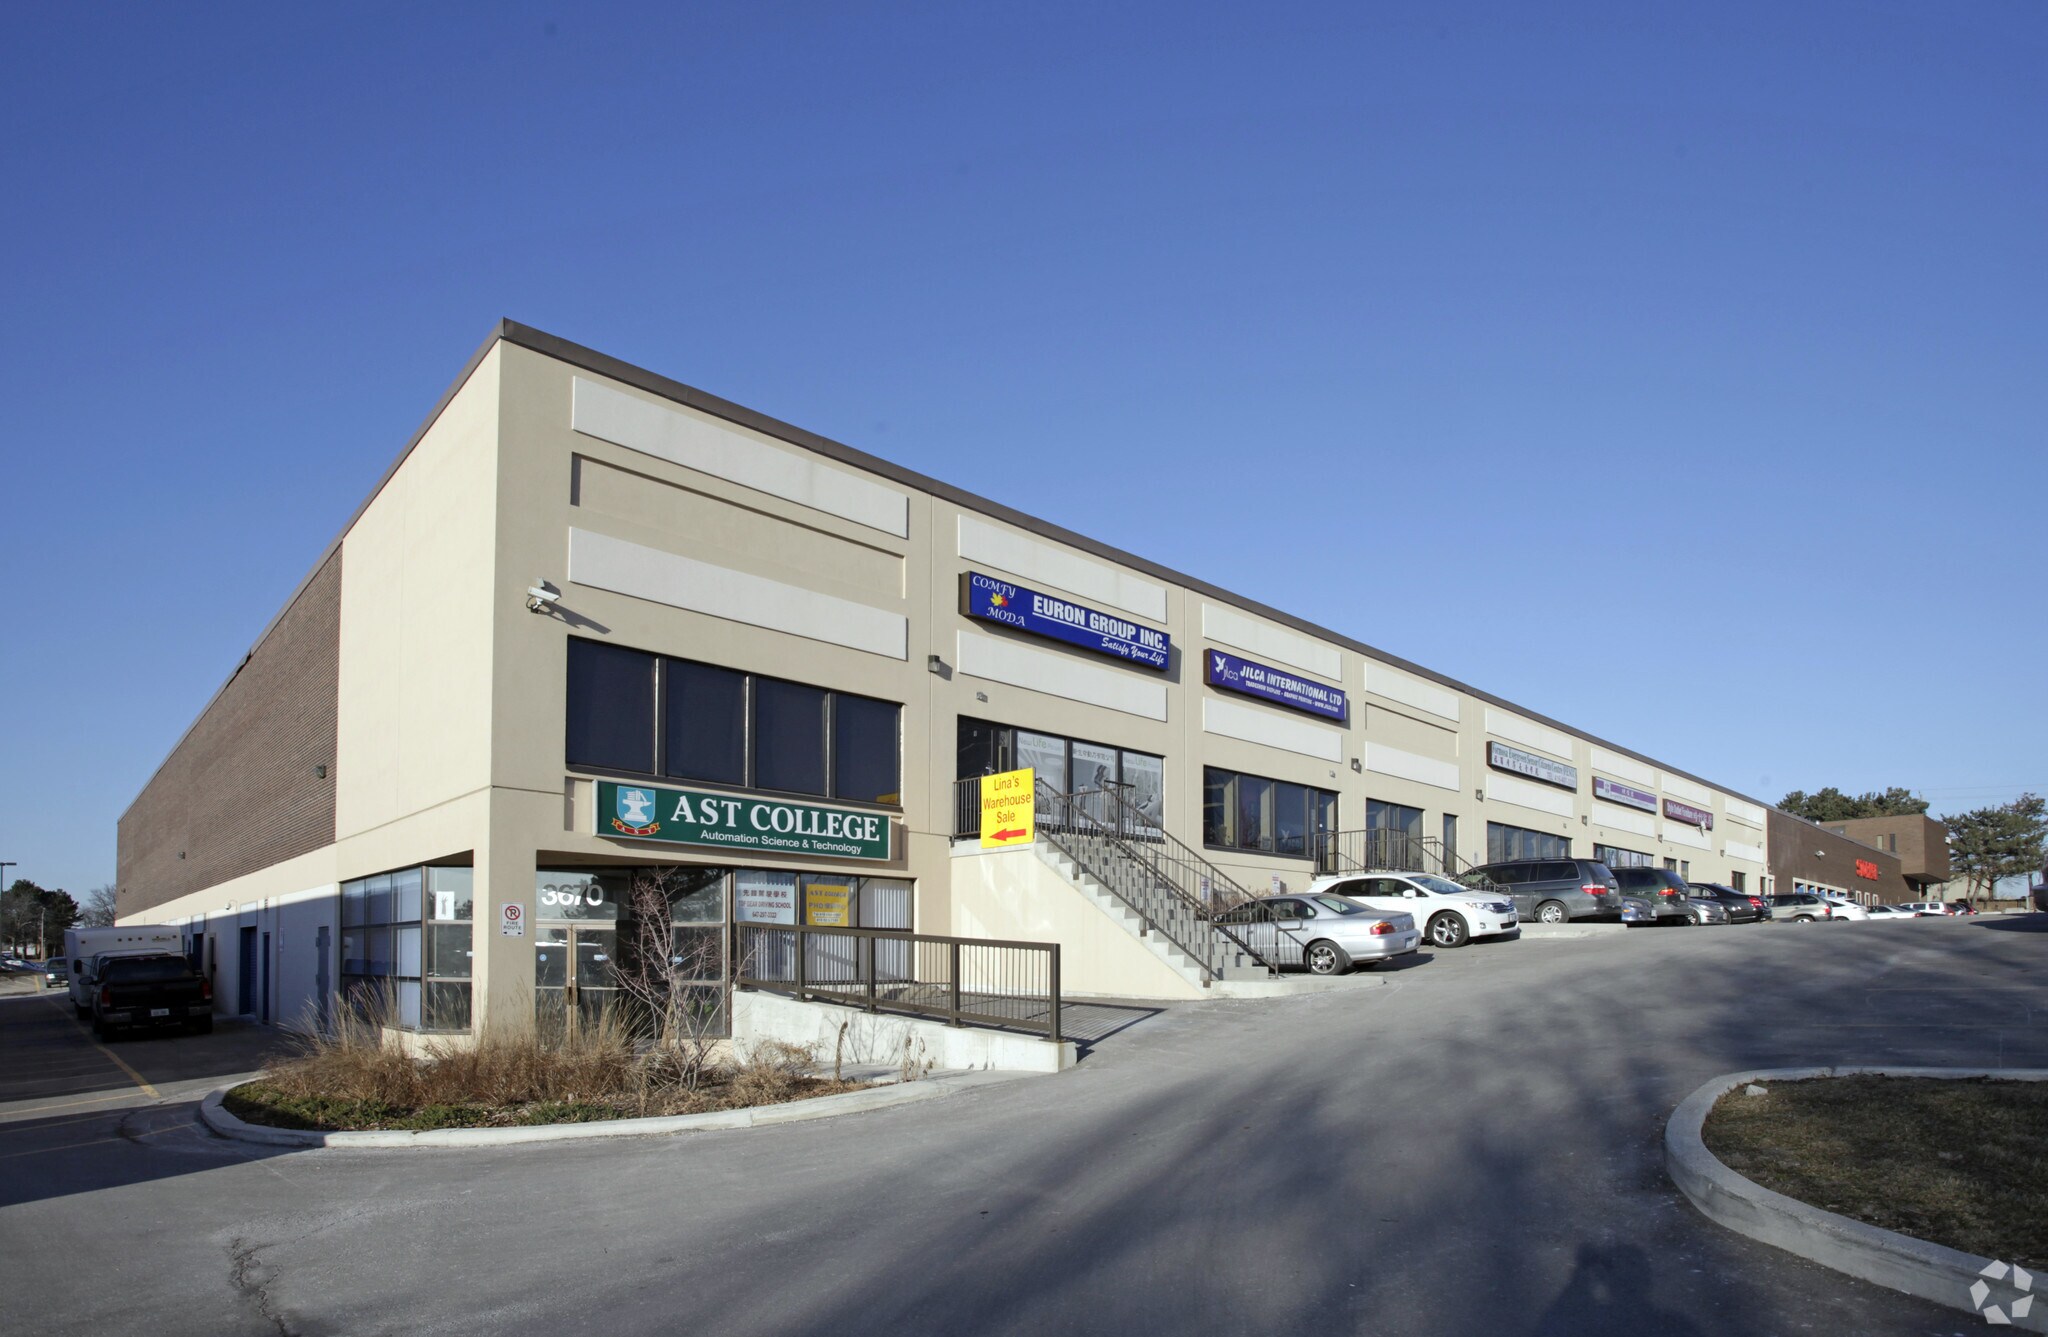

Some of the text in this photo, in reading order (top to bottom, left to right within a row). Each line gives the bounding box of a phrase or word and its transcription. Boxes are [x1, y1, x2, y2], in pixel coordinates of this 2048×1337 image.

[972, 575, 1016, 599] COMFY
[986, 606, 1025, 627] MODA
[1033, 595, 1167, 650] EURON GROUP INC.
[1101, 637, 1165, 666] Satisfy Your Life
[1240, 665, 1343, 706] JILCA INTERNATIONAL LTD
[994, 775, 1020, 791] Lina's
[983, 793, 1031, 810] Warehouse
[671, 795, 880, 842] AST COLLEGE
[996, 811, 1016, 824] Sale
[700, 829, 862, 855] Automation Science & Technology
[541, 883, 604, 906] 3670
